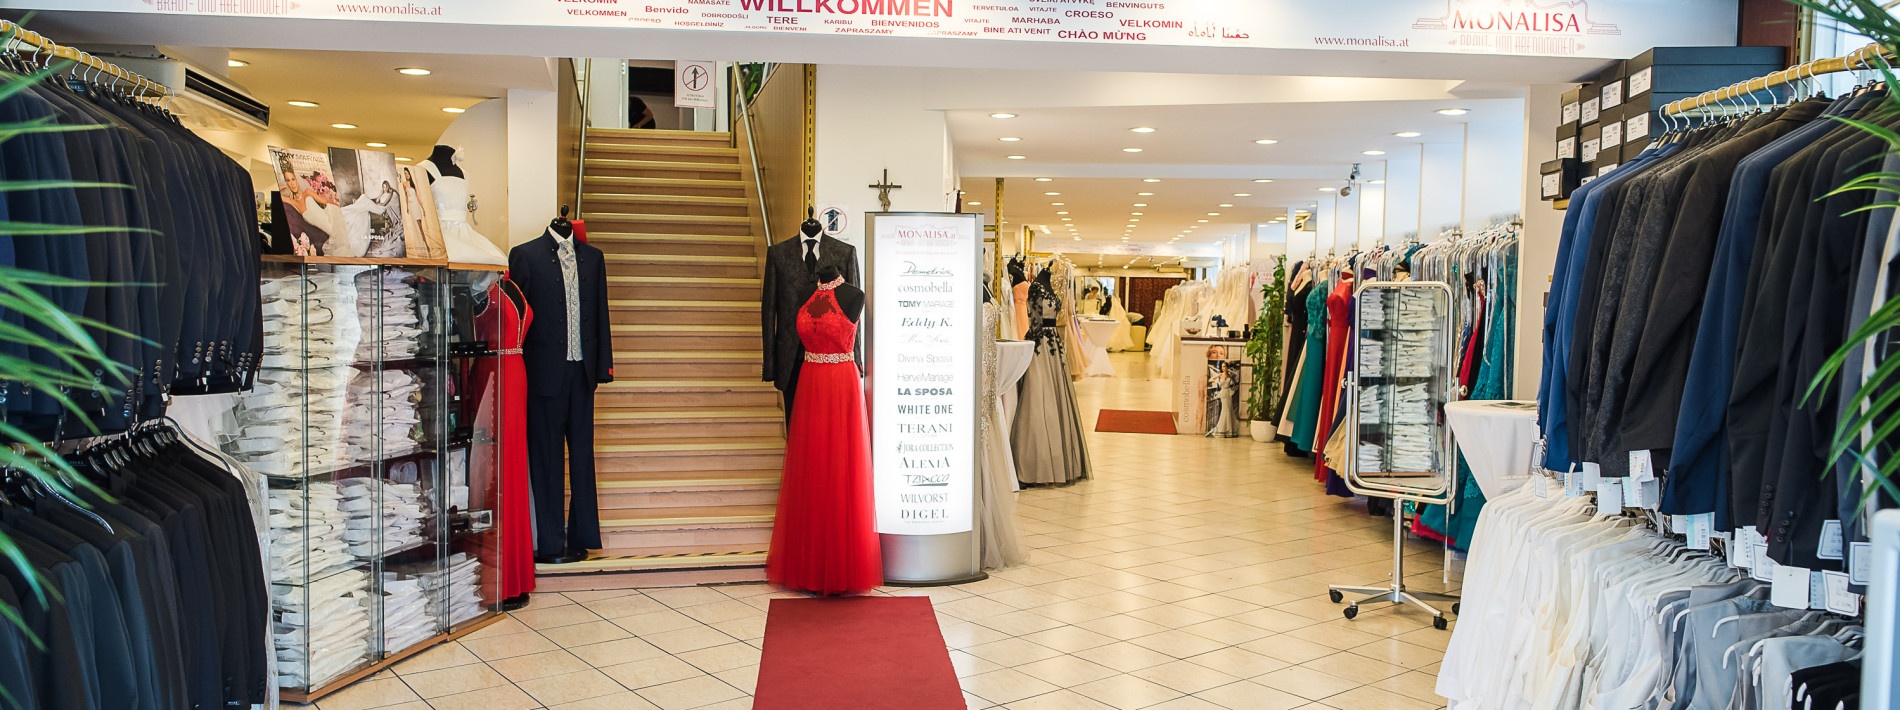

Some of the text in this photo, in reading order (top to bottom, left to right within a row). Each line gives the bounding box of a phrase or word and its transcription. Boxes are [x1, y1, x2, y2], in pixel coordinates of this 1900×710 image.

[337, 3, 441, 15] www.monalisa.at
[741, 0, 952, 17] WILLKOMMEN
[767, 16, 798, 24] TERE
[1120, 19, 1182, 28] VELKOMIN
[1453, 11, 1580, 32] MONALISA
[1315, 36, 1408, 47] www.monalisa.at
[898, 230, 948, 239] MONALISA
[898, 282, 953, 293] cosmobella
[901, 318, 953, 329] Eddy K.
[926, 354, 953, 365] Sposa
[898, 405, 953, 414] WHITE ONE
[897, 423, 953, 433] TERANI
[900, 493, 950, 503] WILVORST
[901, 510, 949, 519] DIGEL
